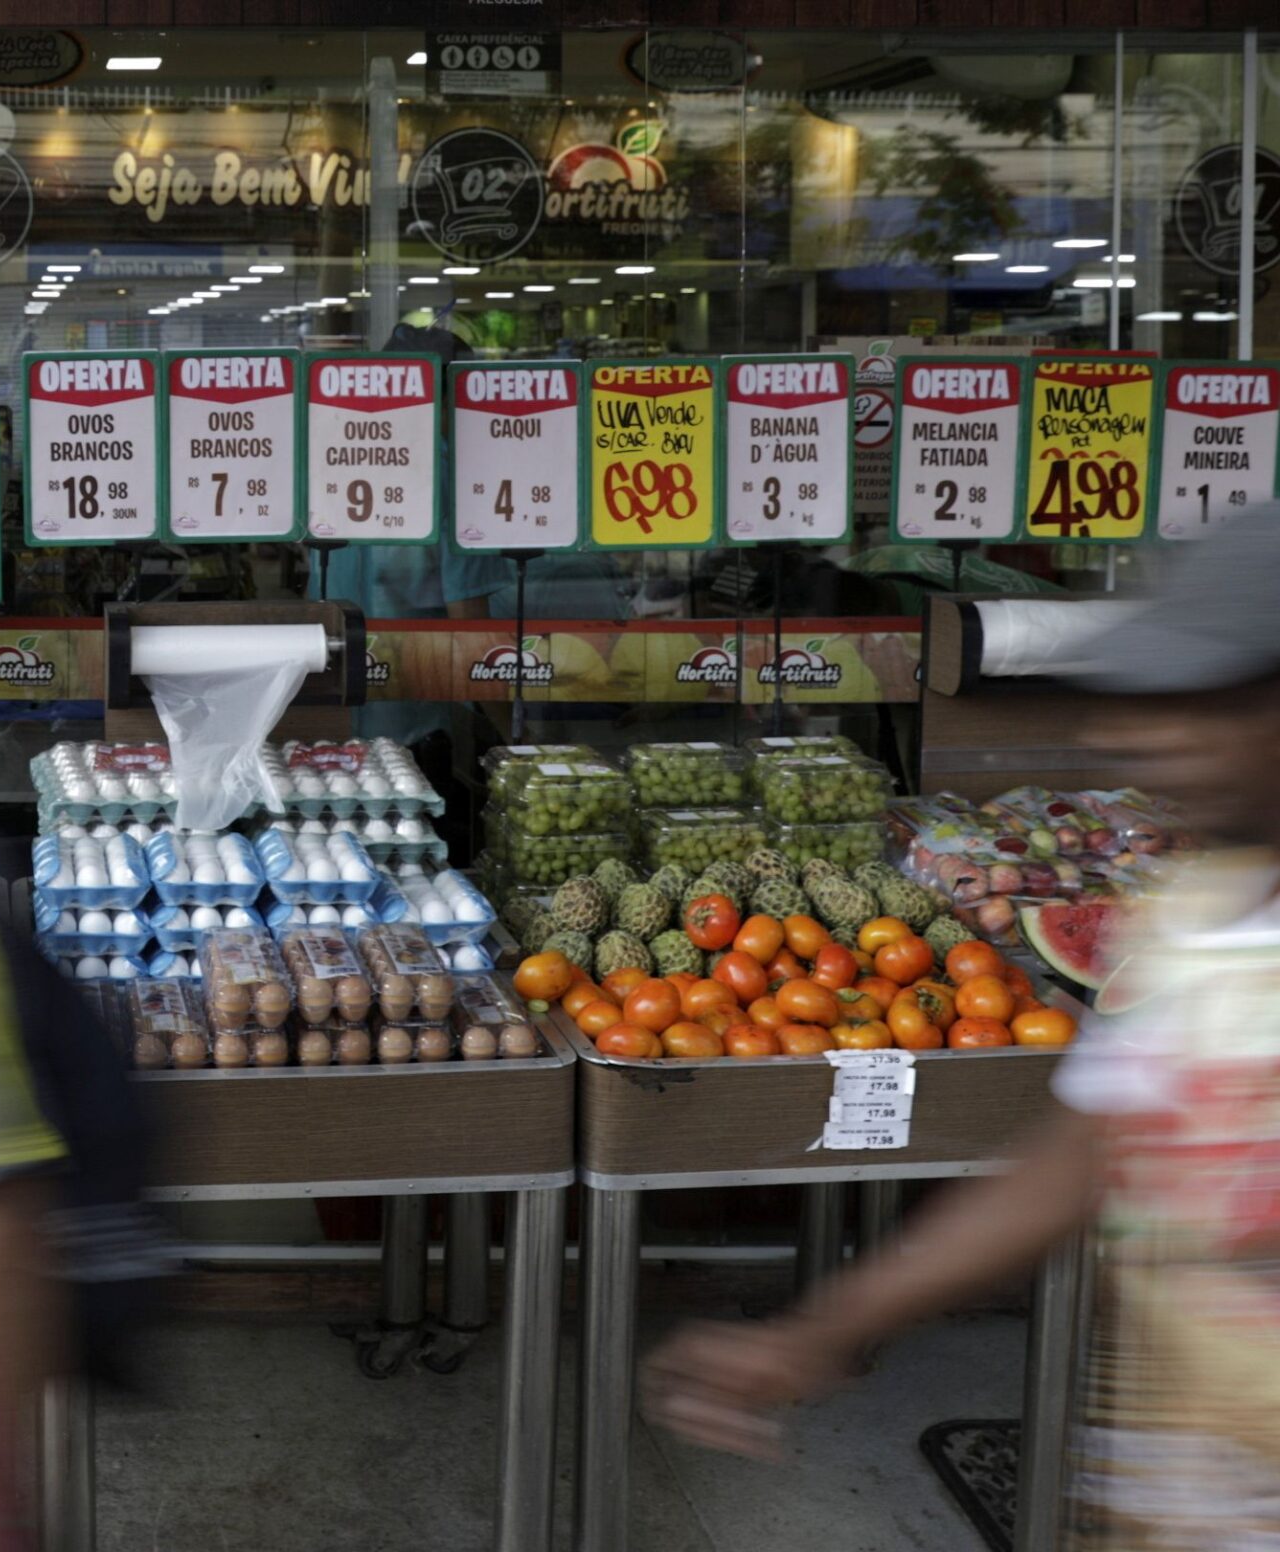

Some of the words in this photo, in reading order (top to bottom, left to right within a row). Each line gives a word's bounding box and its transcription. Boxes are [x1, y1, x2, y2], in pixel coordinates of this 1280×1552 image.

[437, 35, 469, 44] CAIXA
[470, 33, 544, 45] PREFERÊNCIAL
[108, 151, 205, 223] Seja
[211, 151, 303, 207] Bem
[461, 167, 510, 202] 02
[544, 181, 691, 221] ortifruti
[39, 359, 144, 393] OFERTA
[181, 357, 285, 389] OFERTA
[319, 366, 425, 398] OFERTA
[594, 365, 711, 385] OFERTA
[737, 363, 839, 396] OFERTA
[466, 369, 568, 402] OFERTA
[912, 368, 1010, 400] OFERTA
[1177, 374, 1270, 405] OFERTA
[68, 414, 114, 435] OVOS
[208, 411, 254, 432] OVOS
[596, 400, 645, 431] UVA
[646, 398, 705, 427] Verde
[344, 420, 392, 441] OVOS
[490, 418, 542, 441] CAQUI
[750, 416, 820, 438] BANANA
[912, 422, 998, 443] MELANCIA
[1194, 426, 1244, 446] COUVE
[50, 440, 133, 462] BRANCOS
[190, 438, 273, 459] BRANCOS
[326, 446, 410, 468] CAIPIRAS
[920, 447, 988, 467] FATIADA
[1184, 451, 1250, 471] MINEIRA
[48, 480, 60, 492] R$
[108, 482, 128, 500] 98
[188, 477, 200, 489] R$
[247, 479, 267, 497] 98
[326, 483, 338, 495] R$
[384, 486, 404, 504] 98
[473, 483, 485, 495] R$
[531, 486, 551, 503] 98
[742, 481, 753, 493] R$
[798, 483, 818, 500] 98
[968, 488, 987, 503] 98
[1228, 490, 1247, 506] 49
[258, 505, 269, 517] DZ
[535, 515, 548, 527] KG
[802, 513, 814, 526] kg
[870, 1082, 898, 1091] 17.98
[867, 1109, 896, 1118] 17.98
[865, 1136, 894, 1145] 17.98
